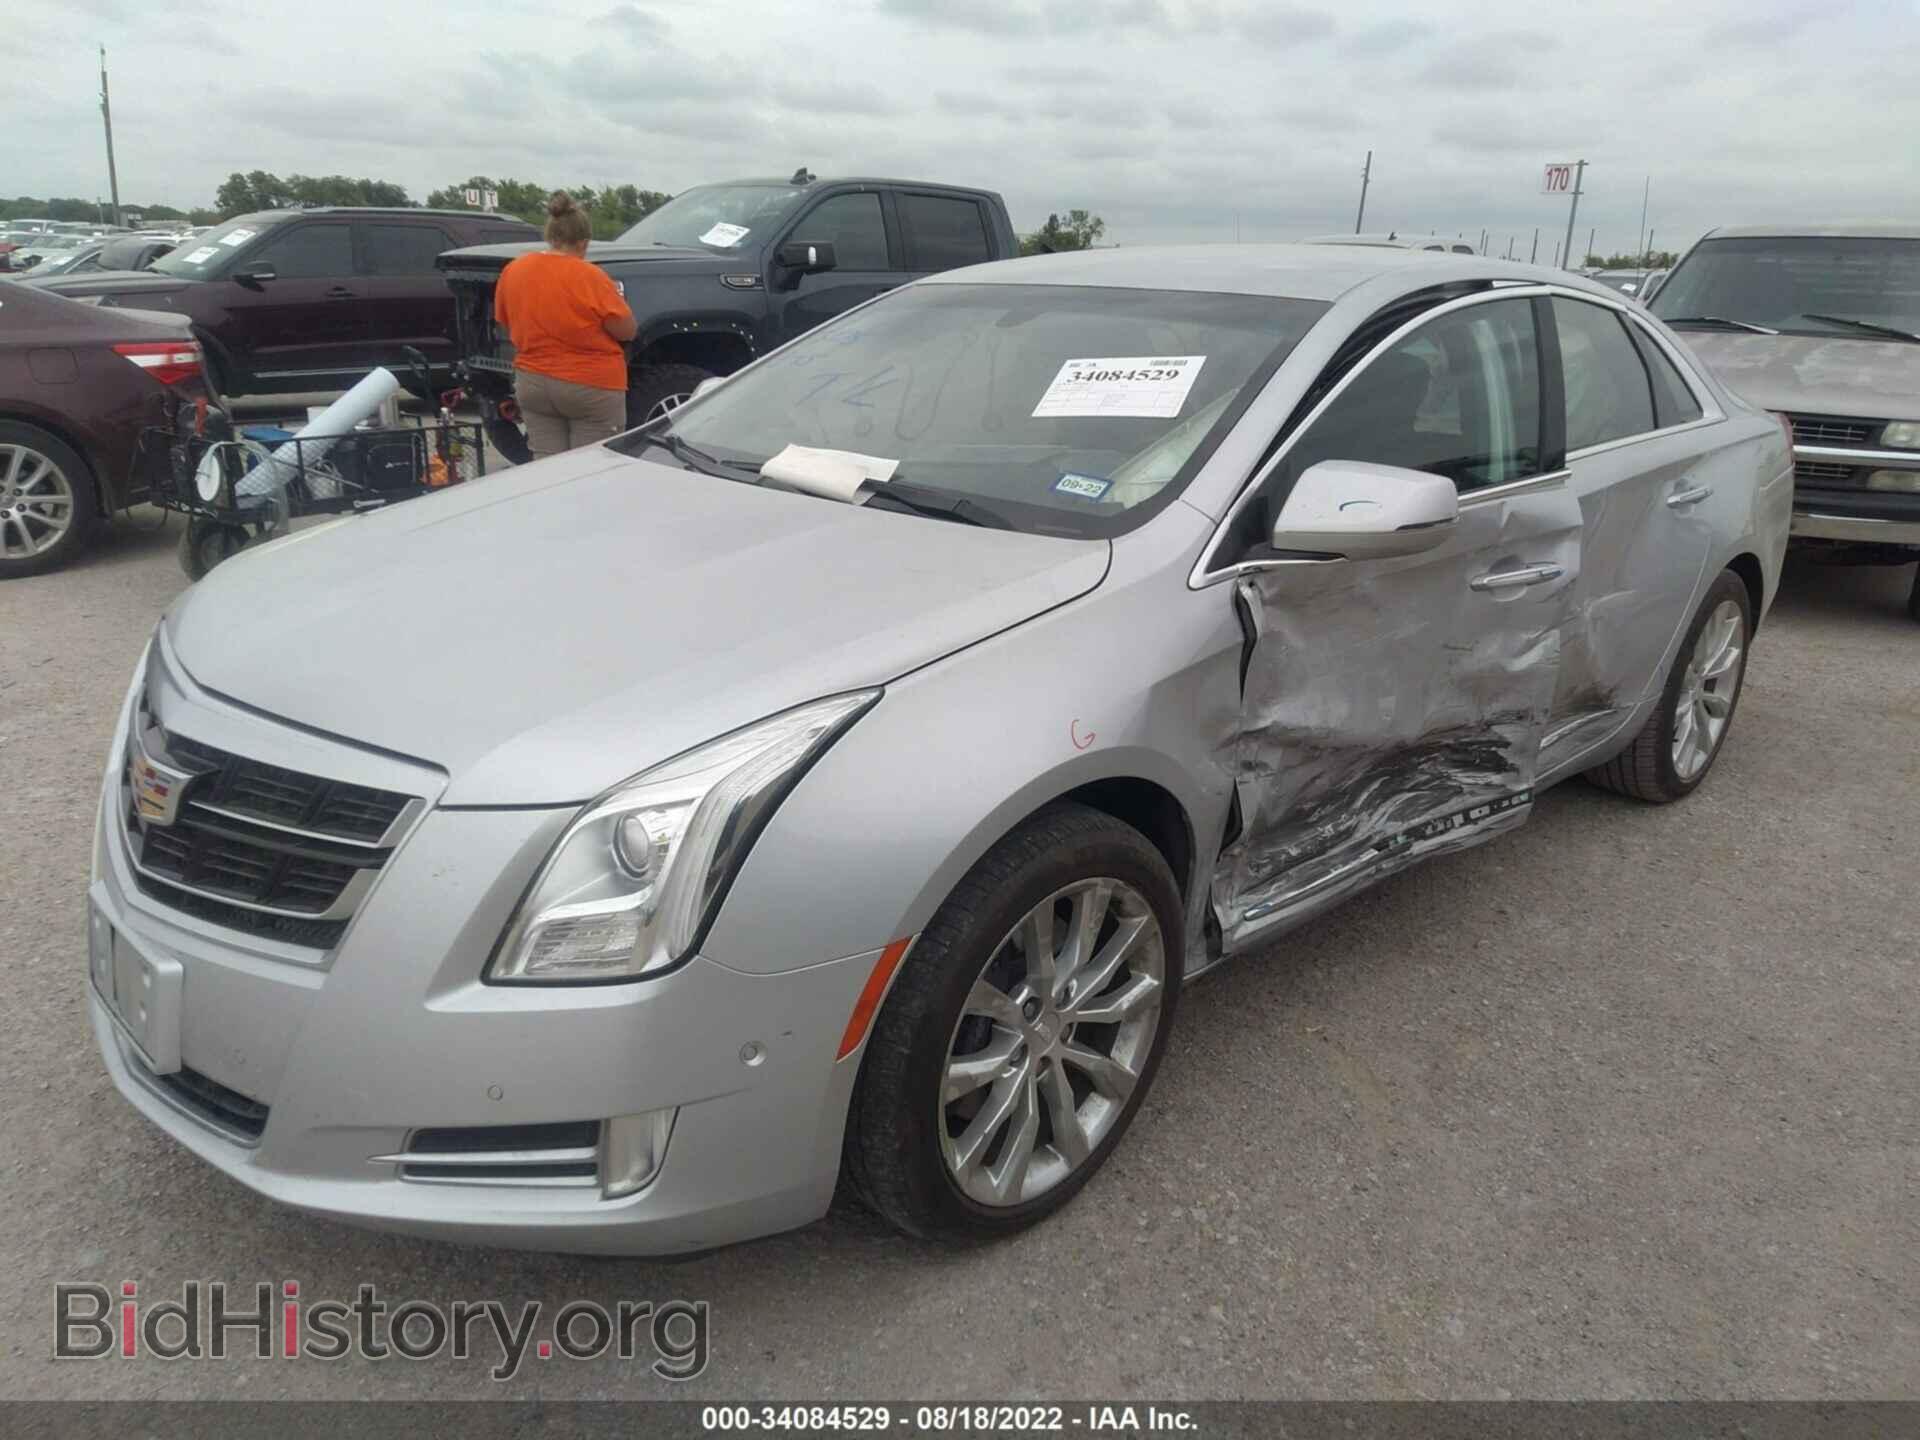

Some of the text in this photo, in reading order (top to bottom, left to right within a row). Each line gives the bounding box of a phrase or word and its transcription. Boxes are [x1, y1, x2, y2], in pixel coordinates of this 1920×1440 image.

[1546, 166, 1570, 192] 170
[468, 190, 478, 204] U
[1071, 369, 1180, 382] 34084529
